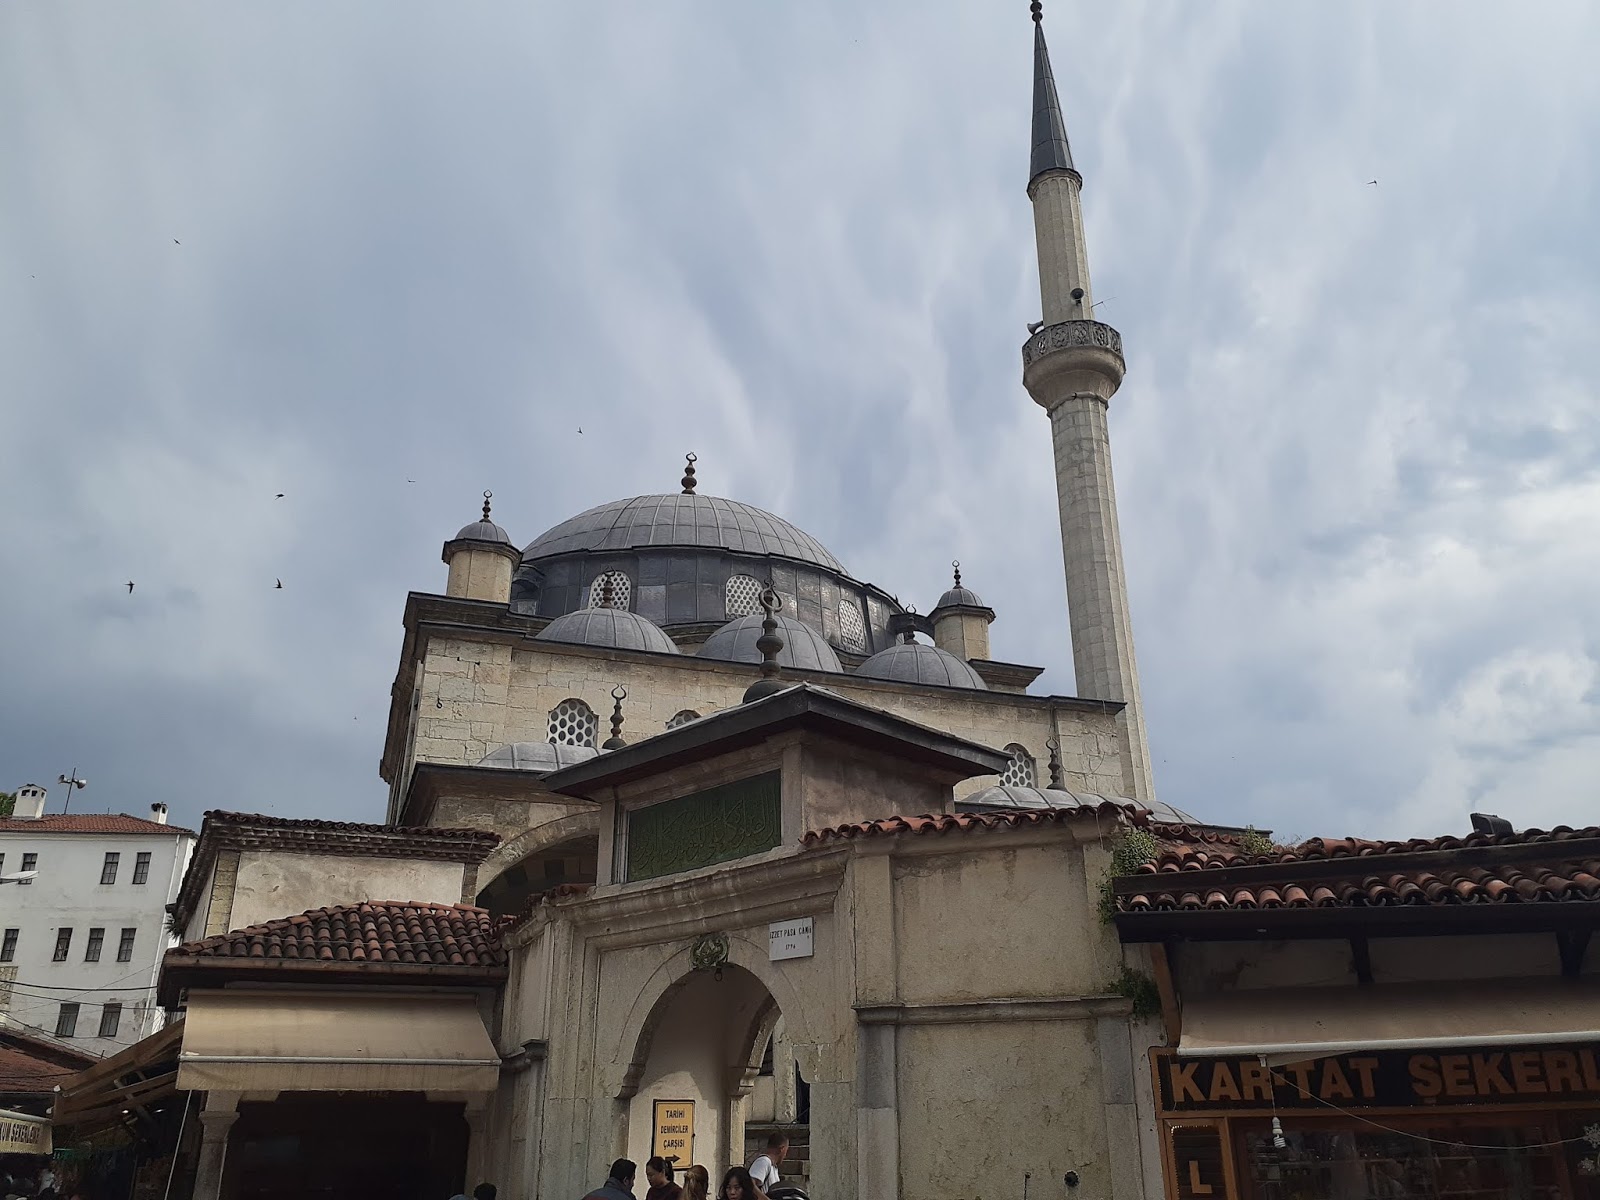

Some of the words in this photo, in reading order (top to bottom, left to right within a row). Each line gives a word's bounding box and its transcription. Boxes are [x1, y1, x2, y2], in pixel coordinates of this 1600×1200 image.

[665, 1108, 685, 1118] TARİHİ
[660, 1124, 689, 1133] DEMİRCİLER
[663, 1139, 685, 1150] ÇARŞISI
